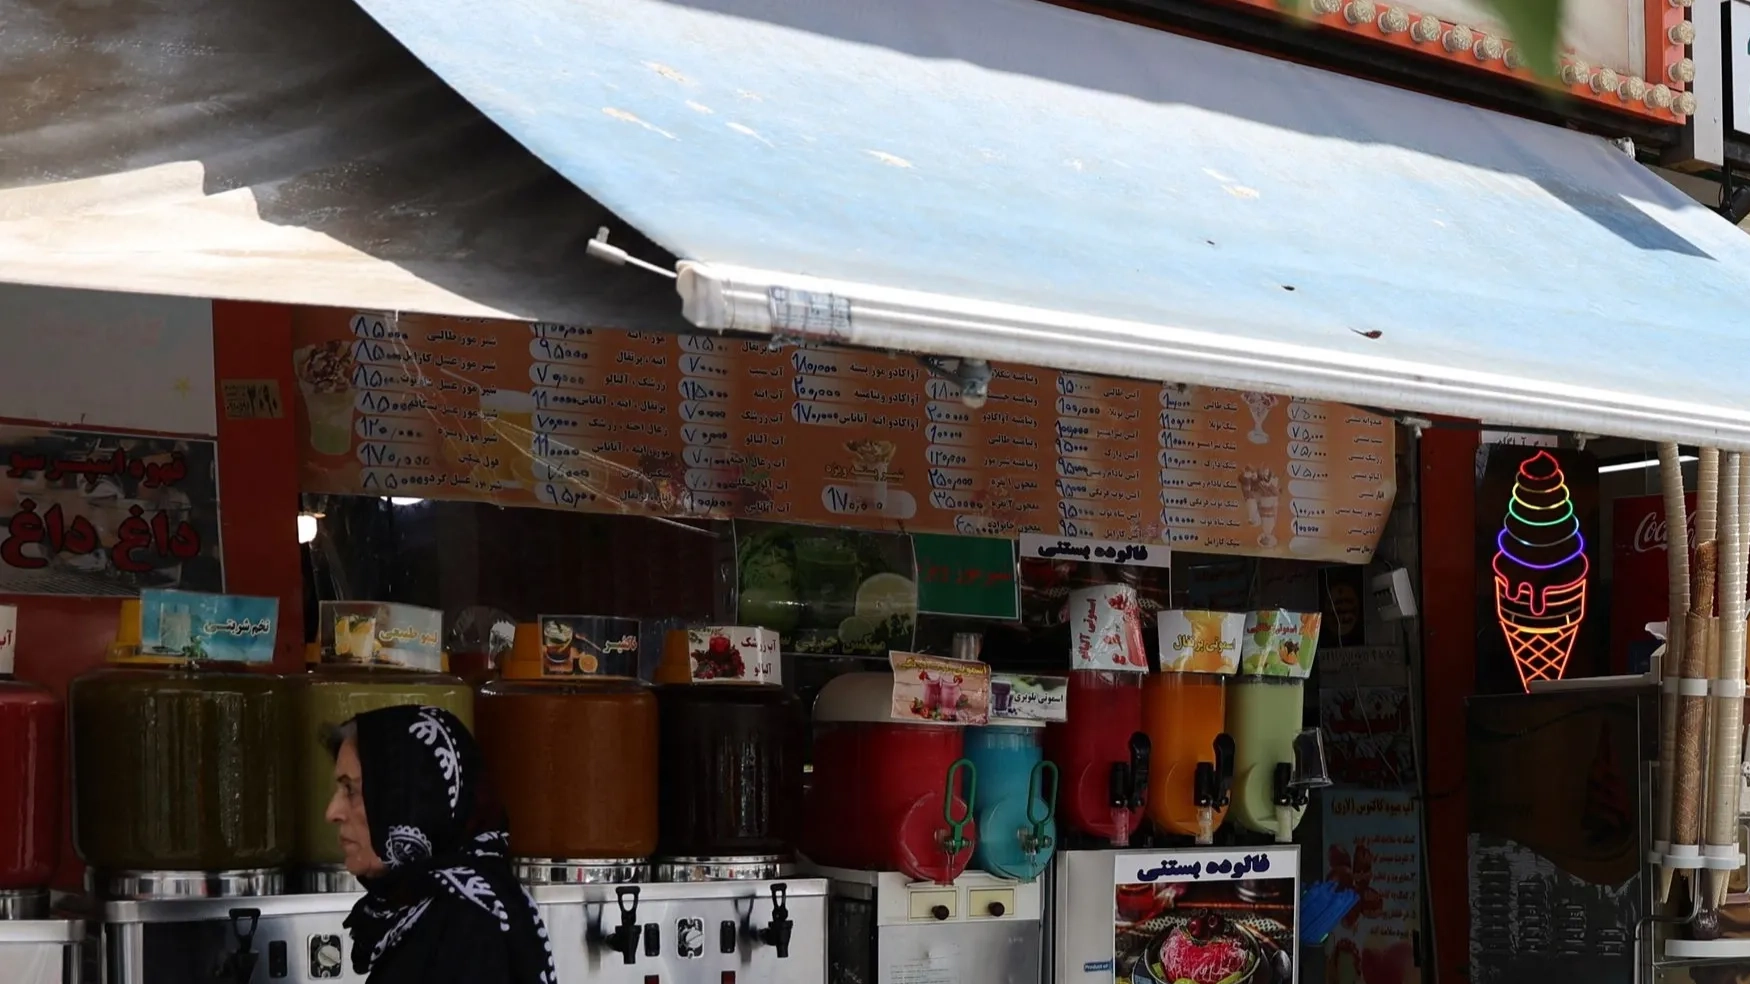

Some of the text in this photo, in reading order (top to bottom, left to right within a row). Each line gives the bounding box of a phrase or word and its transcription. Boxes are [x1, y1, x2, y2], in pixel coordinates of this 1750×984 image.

[1, 498, 200, 573] داغ داغ
[1038, 541, 1148, 563] فالوده بستنی
[1137, 854, 1270, 882] فالوده بستنی
